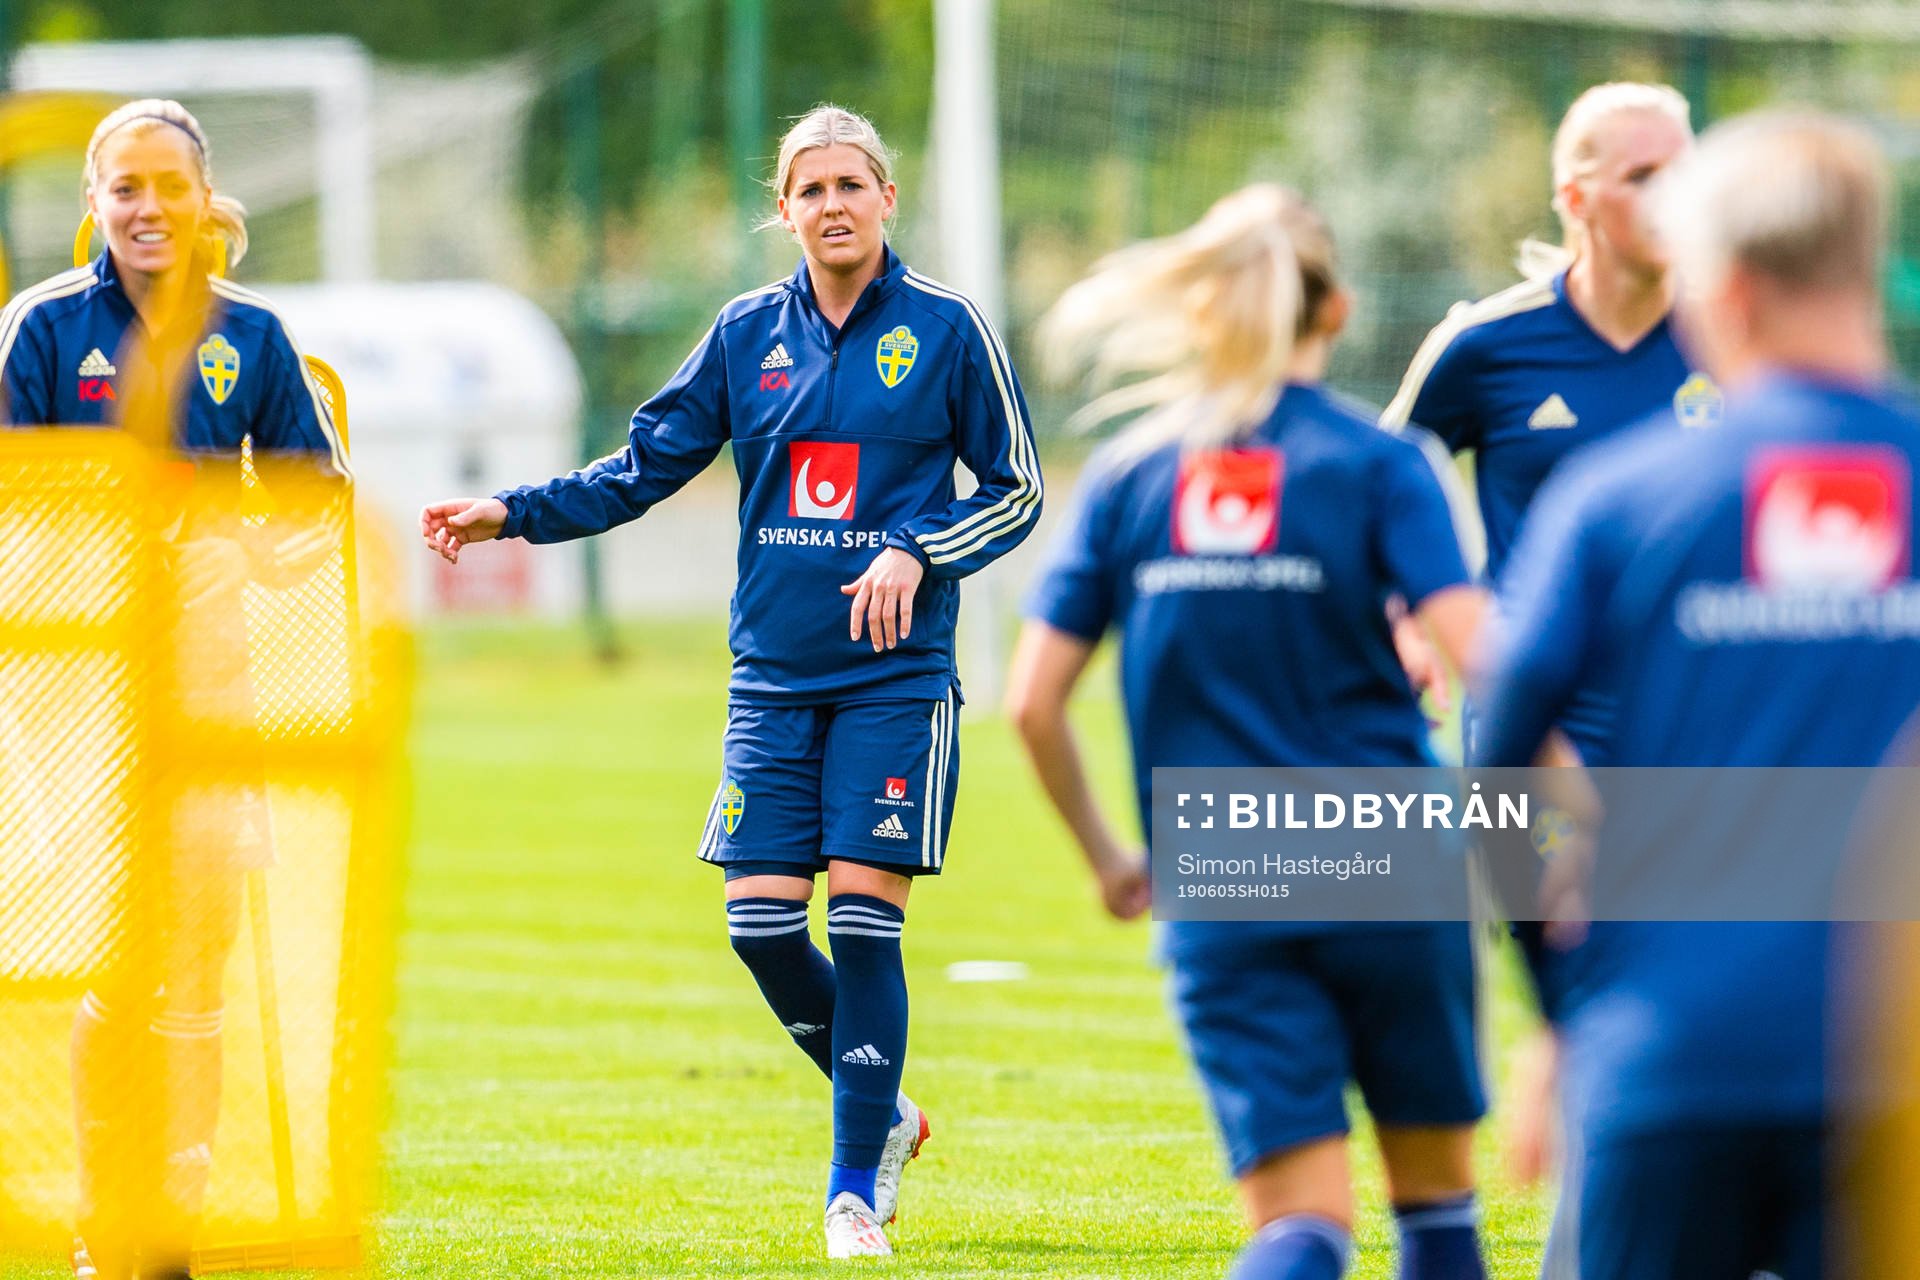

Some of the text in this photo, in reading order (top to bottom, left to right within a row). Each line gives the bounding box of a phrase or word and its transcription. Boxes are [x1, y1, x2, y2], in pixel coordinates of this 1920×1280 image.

[760, 358, 794, 370] adidas
[759, 372, 791, 392] ICA
[79, 379, 116, 400] ICA
[758, 528, 836, 547] SVENSKA
[874, 798, 900, 806] SVENSKA
[872, 828, 909, 840] adidas
[841, 1054, 890, 1066] adidas
